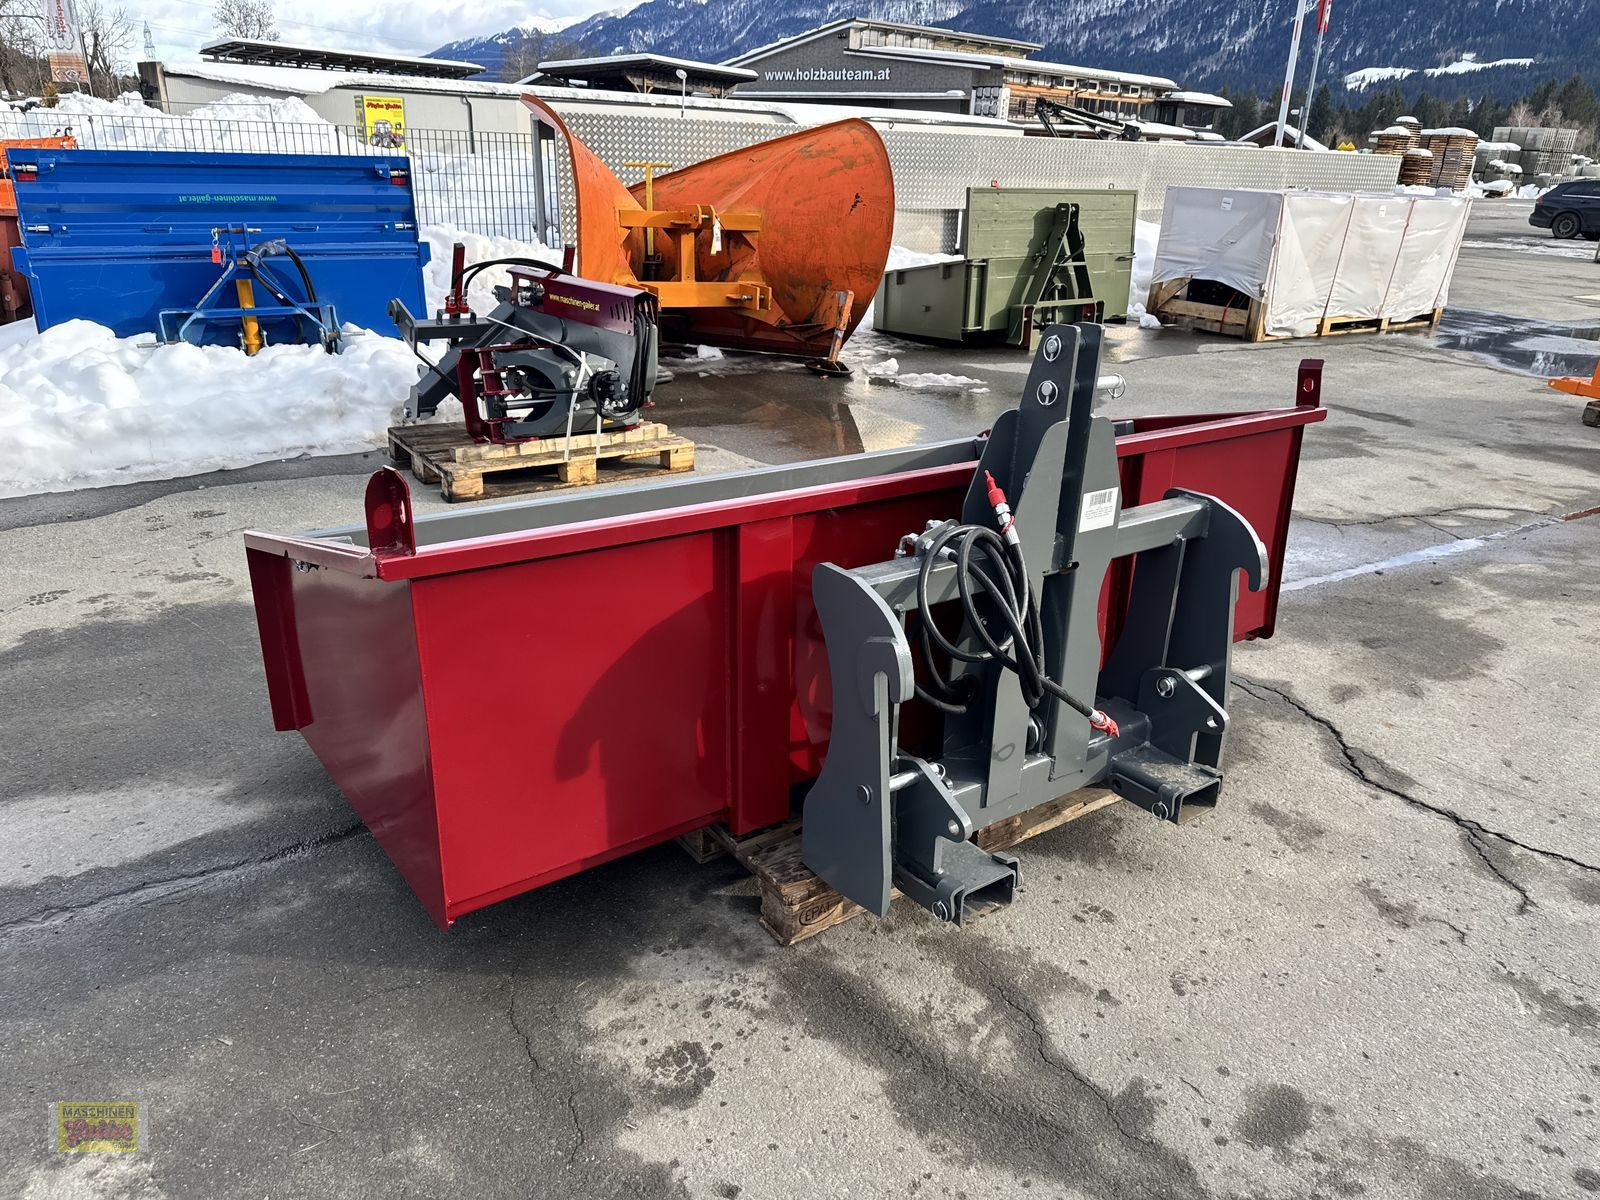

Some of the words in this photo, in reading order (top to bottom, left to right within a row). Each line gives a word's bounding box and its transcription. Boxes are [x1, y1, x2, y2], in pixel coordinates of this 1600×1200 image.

[765, 67, 890, 81] www.holzbauteam.at
[179, 194, 277, 203] www.maschinen-gailer.at
[549, 293, 600, 312] www.maschinen-gailer.at
